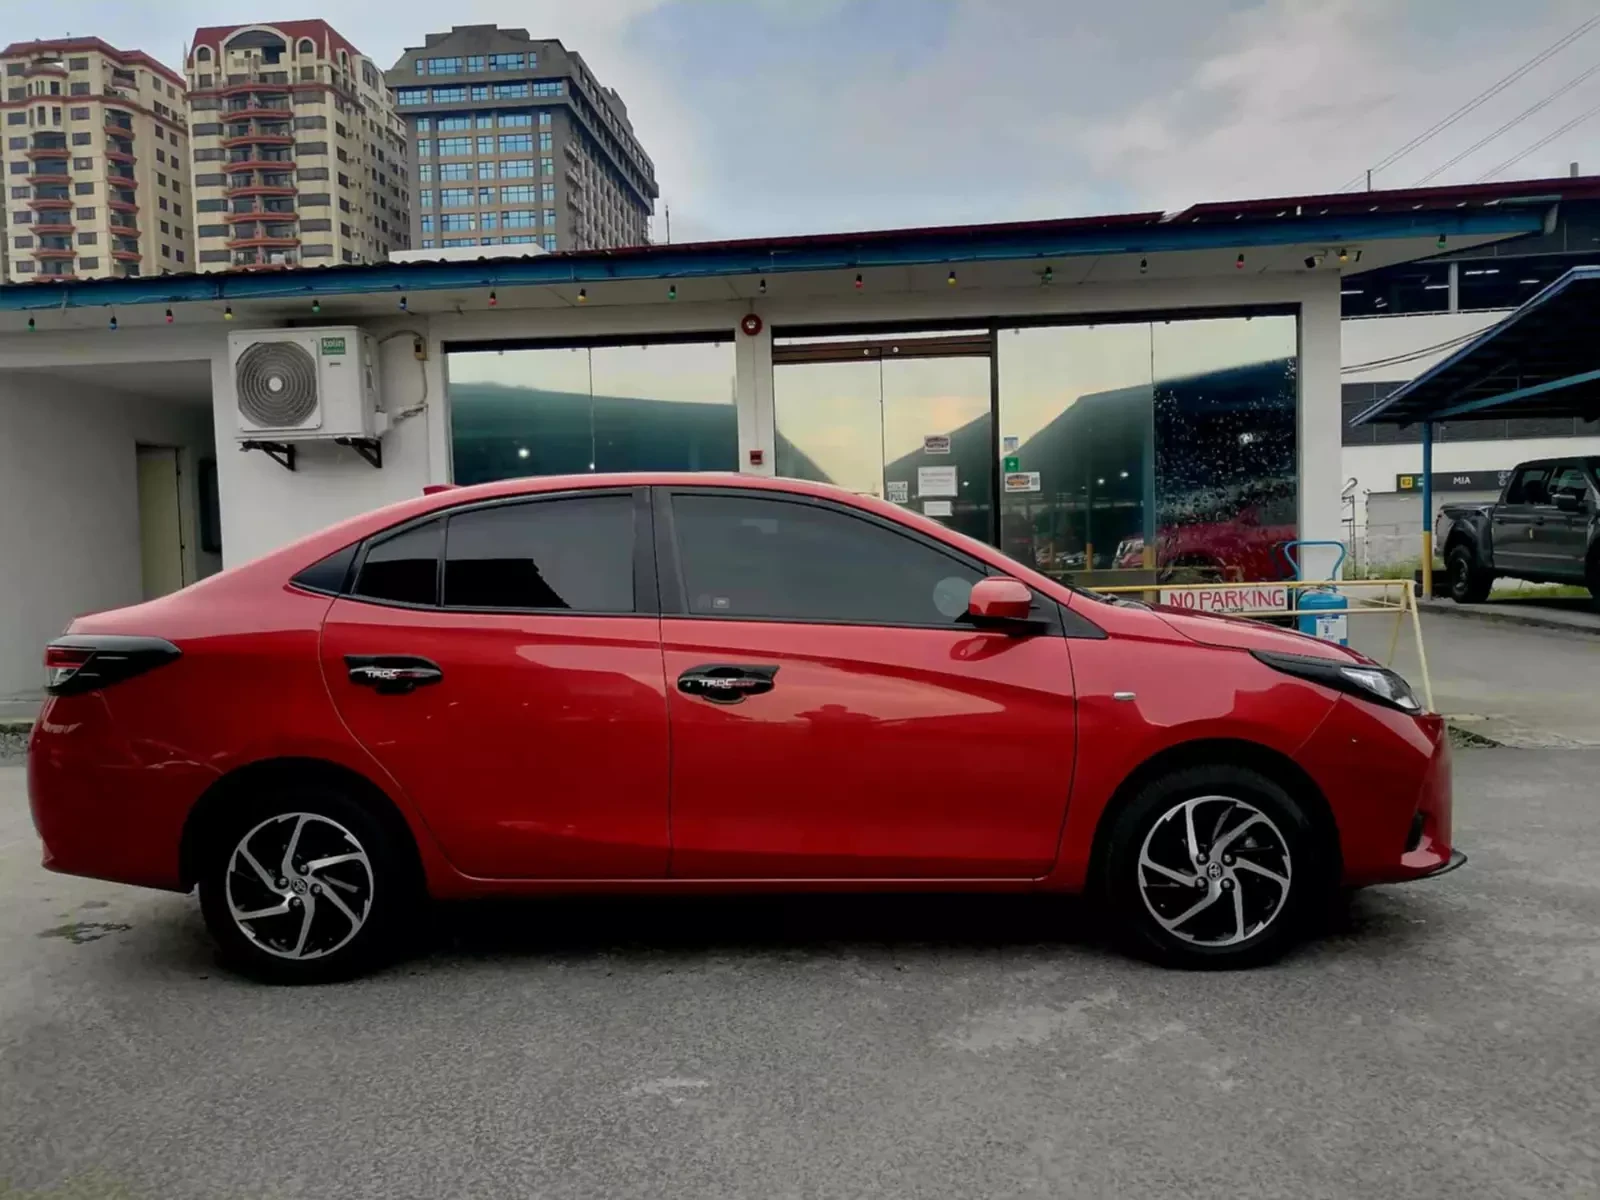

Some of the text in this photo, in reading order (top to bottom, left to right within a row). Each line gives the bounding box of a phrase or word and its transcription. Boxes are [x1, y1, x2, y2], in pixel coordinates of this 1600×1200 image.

[1453, 476, 1472, 485] MIA
[1169, 589, 1285, 610] NO PARKING
